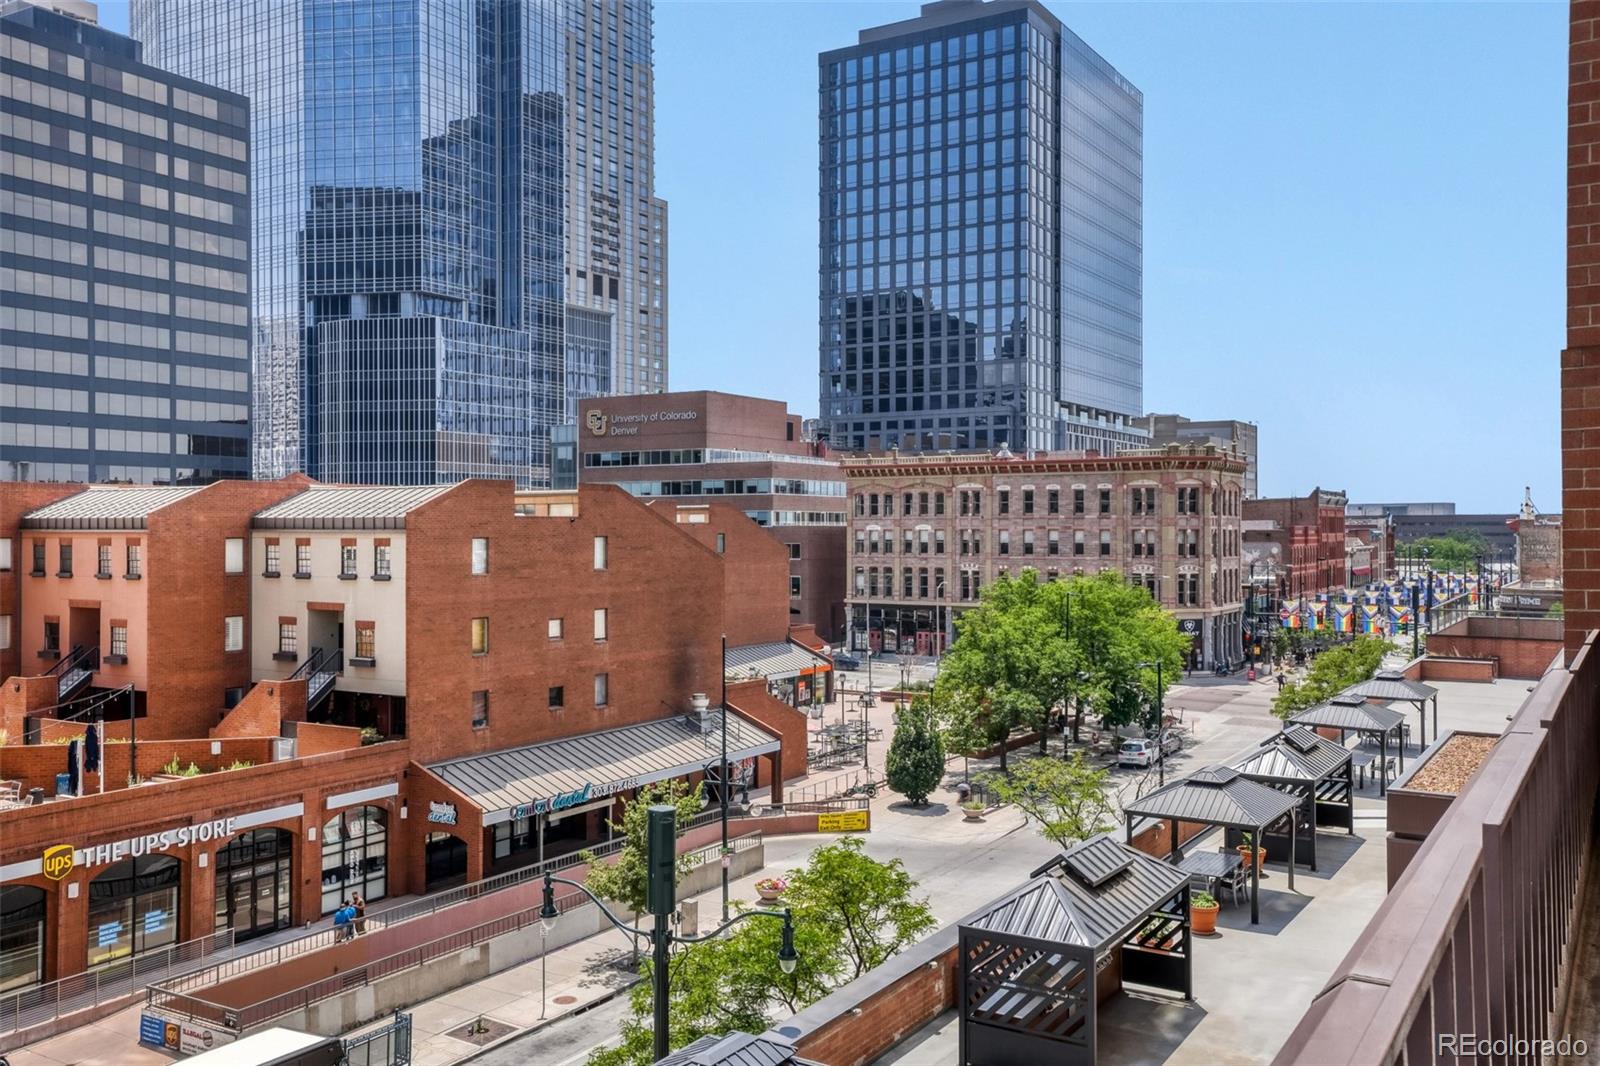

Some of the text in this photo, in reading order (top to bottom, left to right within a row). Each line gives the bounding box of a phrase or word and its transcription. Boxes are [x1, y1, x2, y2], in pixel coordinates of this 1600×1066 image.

[611, 410, 697, 424] University of Colorado
[611, 426, 638, 435] Denver
[551, 782, 593, 811] dental
[46, 817, 236, 875] ups THE UPS STORE
